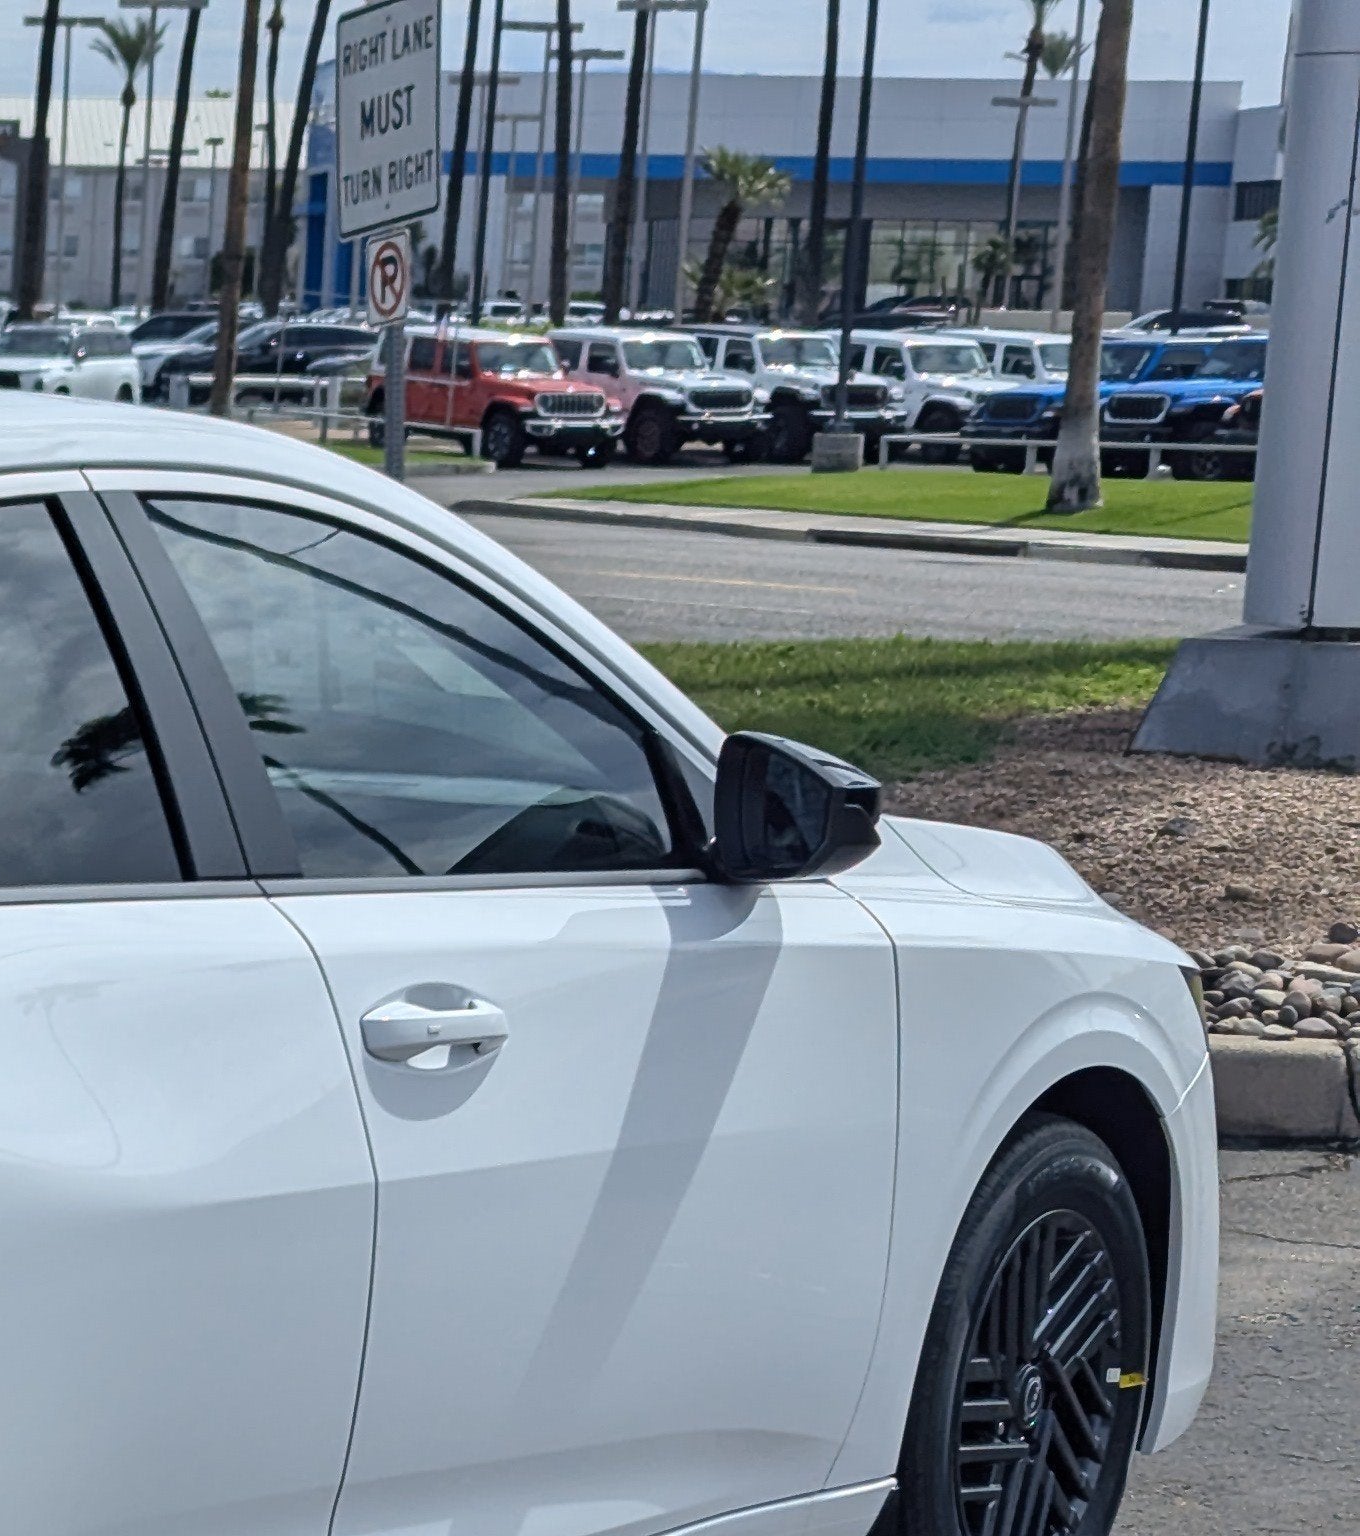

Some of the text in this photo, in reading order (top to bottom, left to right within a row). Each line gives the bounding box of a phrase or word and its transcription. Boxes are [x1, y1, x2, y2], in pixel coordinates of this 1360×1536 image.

[342, 14, 434, 77] RIGHT LANE
[360, 84, 415, 141] MUST
[343, 149, 433, 206] TURN RIGHT
